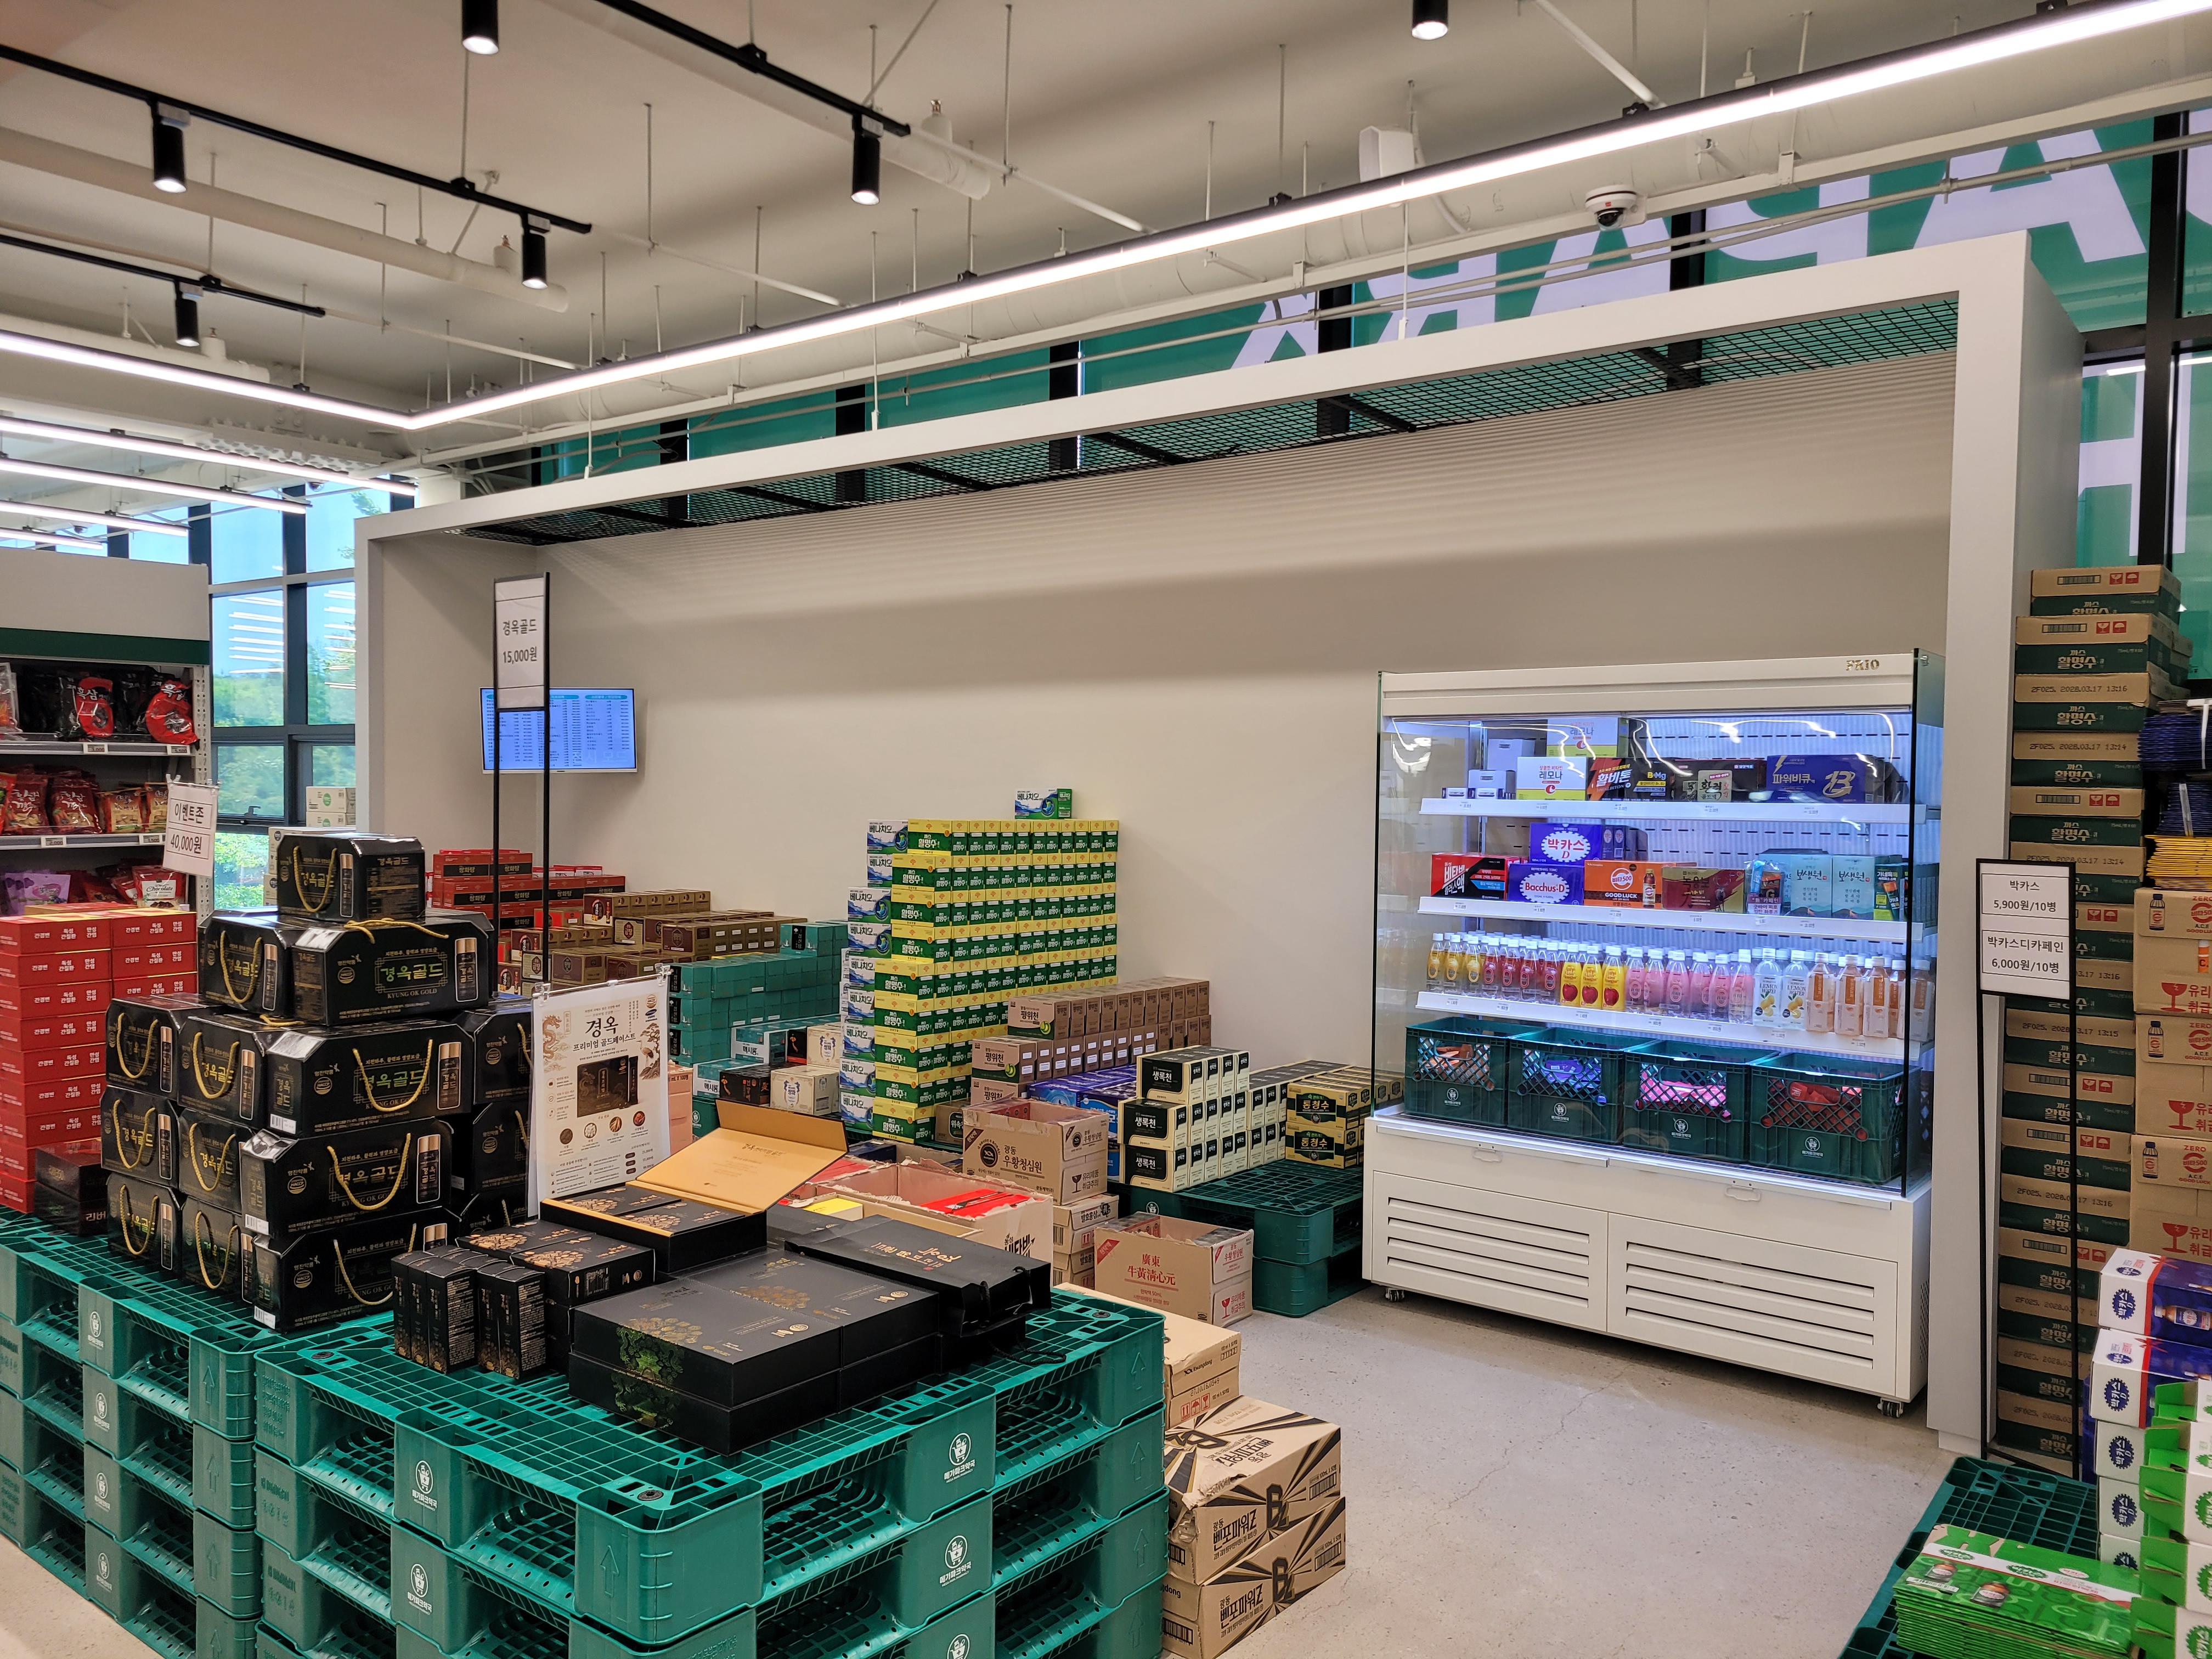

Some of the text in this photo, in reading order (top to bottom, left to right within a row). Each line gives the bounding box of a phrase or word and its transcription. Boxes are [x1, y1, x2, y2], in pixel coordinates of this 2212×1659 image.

[503, 619, 537, 636] 경옥골드
[503, 646, 537, 664] 15,000원
[1846, 659, 1880, 670] FRIO
[2057, 656, 2097, 669] 활명수
[2057, 713, 2096, 725] 활명수
[1539, 770, 1563, 780] 레모나
[1596, 769, 1633, 787] 활비톤
[1771, 773, 1810, 785] 파워비큐
[2055, 770, 2094, 783] 활명수
[1017, 793, 1039, 801] 베나치오
[174, 804, 204, 823] 이벤트존
[870, 825, 892, 833] 베나치오
[2051, 828, 2091, 841] 활명수
[171, 833, 201, 854] 40,000원
[918, 838, 936, 848] 활명수
[1548, 838, 1584, 851] 박카스
[902, 874, 921, 884] 활명수
[1797, 870, 1822, 881] 보생원
[1838, 871, 1865, 882] 보생원
[2010, 880, 2040, 892] 박카스
[850, 893, 872, 902] 베나치오
[1993, 900, 2056, 913] 5,900원/10병
[901, 909, 919, 919] 활명수
[850, 927, 873, 935] 베나치오
[1988, 936, 2064, 953] 박카스디카페인
[381, 963, 443, 982] 경옥골드
[1991, 959, 2059, 974] 6,000원/10병
[2098, 972, 2120, 980] 13:16
[585, 1016, 618, 1037] 경옥
[847, 1029, 868, 1039] 베나치오
[573, 1033, 636, 1051] 프리미엄 골드페이스트
[842, 1064, 864, 1074] 베나치오
[1152, 1070, 1172, 1083] 생록천
[843, 1098, 864, 1109] 베나치오
[1302, 1099, 1329, 1109] 통청수
[1135, 1116, 1156, 1129] 생록천
[1084, 1132, 1102, 1142] 우황청심원
[1301, 1137, 1328, 1147] 통청수
[1004, 1145, 1017, 1154] 광동
[1003, 1156, 1042, 1174] 우황청심원
[1136, 1157, 1156, 1170] 생록천
[1082, 1170, 1098, 1181] 유리제품
[1082, 1180, 1098, 1190] 취급주의
[2017, 1188, 2113, 1207] 2F025. 13:16
[1081, 1210, 1097, 1222] 발효홍삼
[1142, 1254, 1160, 1267] 廣東
[1224, 1248, 1243, 1261] 우황청심원
[1231, 1291, 1245, 1304] 유리제품
[1231, 1301, 1245, 1313] 취급주의
[2118, 1292, 2128, 1317] 박카스
[1193, 1359, 1212, 1372] Kwangdong
[2111, 1381, 2121, 1408] 박카스
[2115, 1440, 2126, 1465] 박카스
[944, 1459, 975, 1481] 메가파크약국
[412, 1488, 437, 1509] 메가파크약국
[2118, 1497, 2129, 1523] 박카스
[1213, 1518, 1224, 1531] 광동
[1213, 1508, 1257, 1551] 벤포파워Z
[939, 1561, 972, 1584] 메가파크약국
[407, 1591, 432, 1613] 메가파크약국
[1220, 1595, 1230, 1609] 광동
[1220, 1583, 1263, 1629] 벤포파워Z
